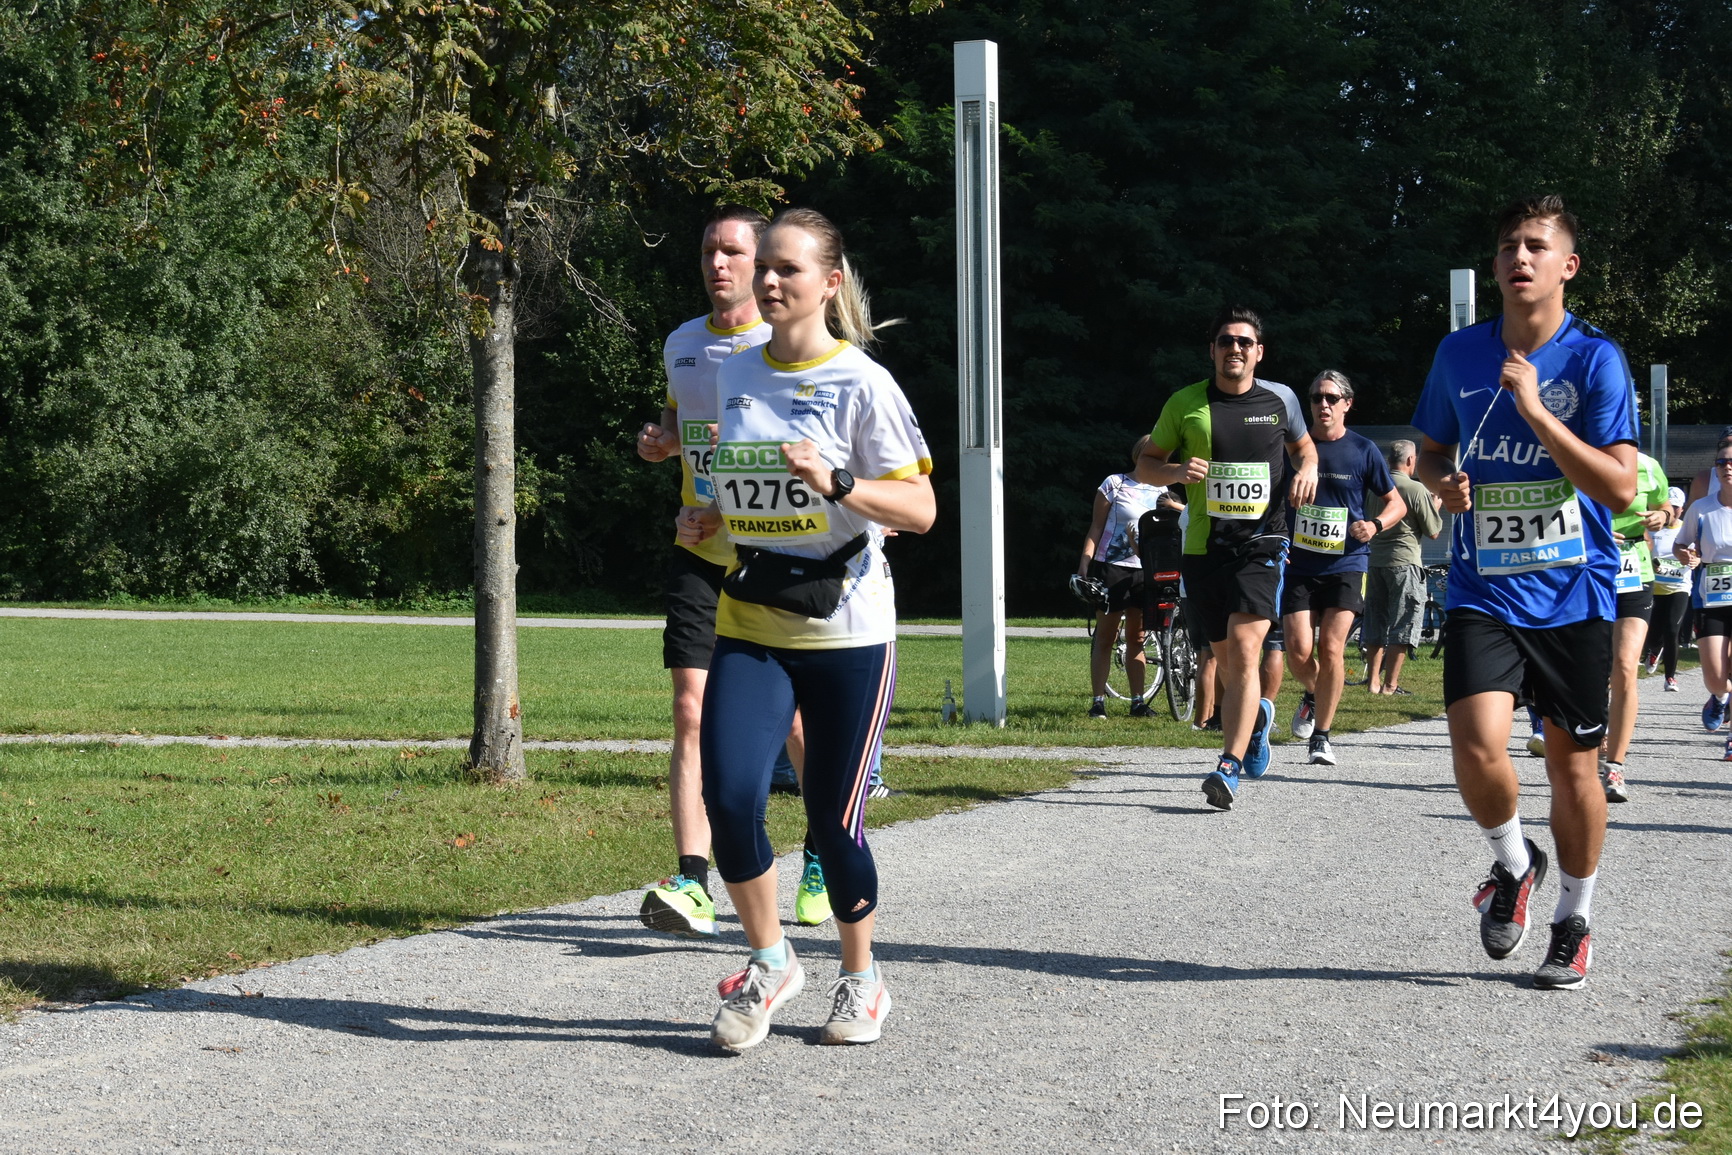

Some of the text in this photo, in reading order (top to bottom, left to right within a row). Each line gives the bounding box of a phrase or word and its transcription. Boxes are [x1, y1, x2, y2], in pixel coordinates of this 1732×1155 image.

[796, 384, 815, 397] 20
[727, 399, 752, 407] BOCK
[792, 399, 838, 410] Neumarkter
[790, 408, 826, 418] Stadtlauf
[1468, 435, 1551, 466] #LÄUF
[1211, 465, 1262, 477] BOCK
[724, 478, 810, 510] 1276
[1213, 483, 1263, 500] 1109
[1484, 484, 1563, 506] BOCK
[1219, 504, 1255, 512] ROMAN
[1301, 505, 1342, 519] BOCK
[729, 518, 818, 533] FRANZISKA
[1301, 519, 1340, 538] 1184
[1486, 510, 1566, 543] 2311
[1302, 537, 1335, 549] MARKUS
[1501, 546, 1560, 564] FABIAN
[1711, 577, 1731, 590] 25
